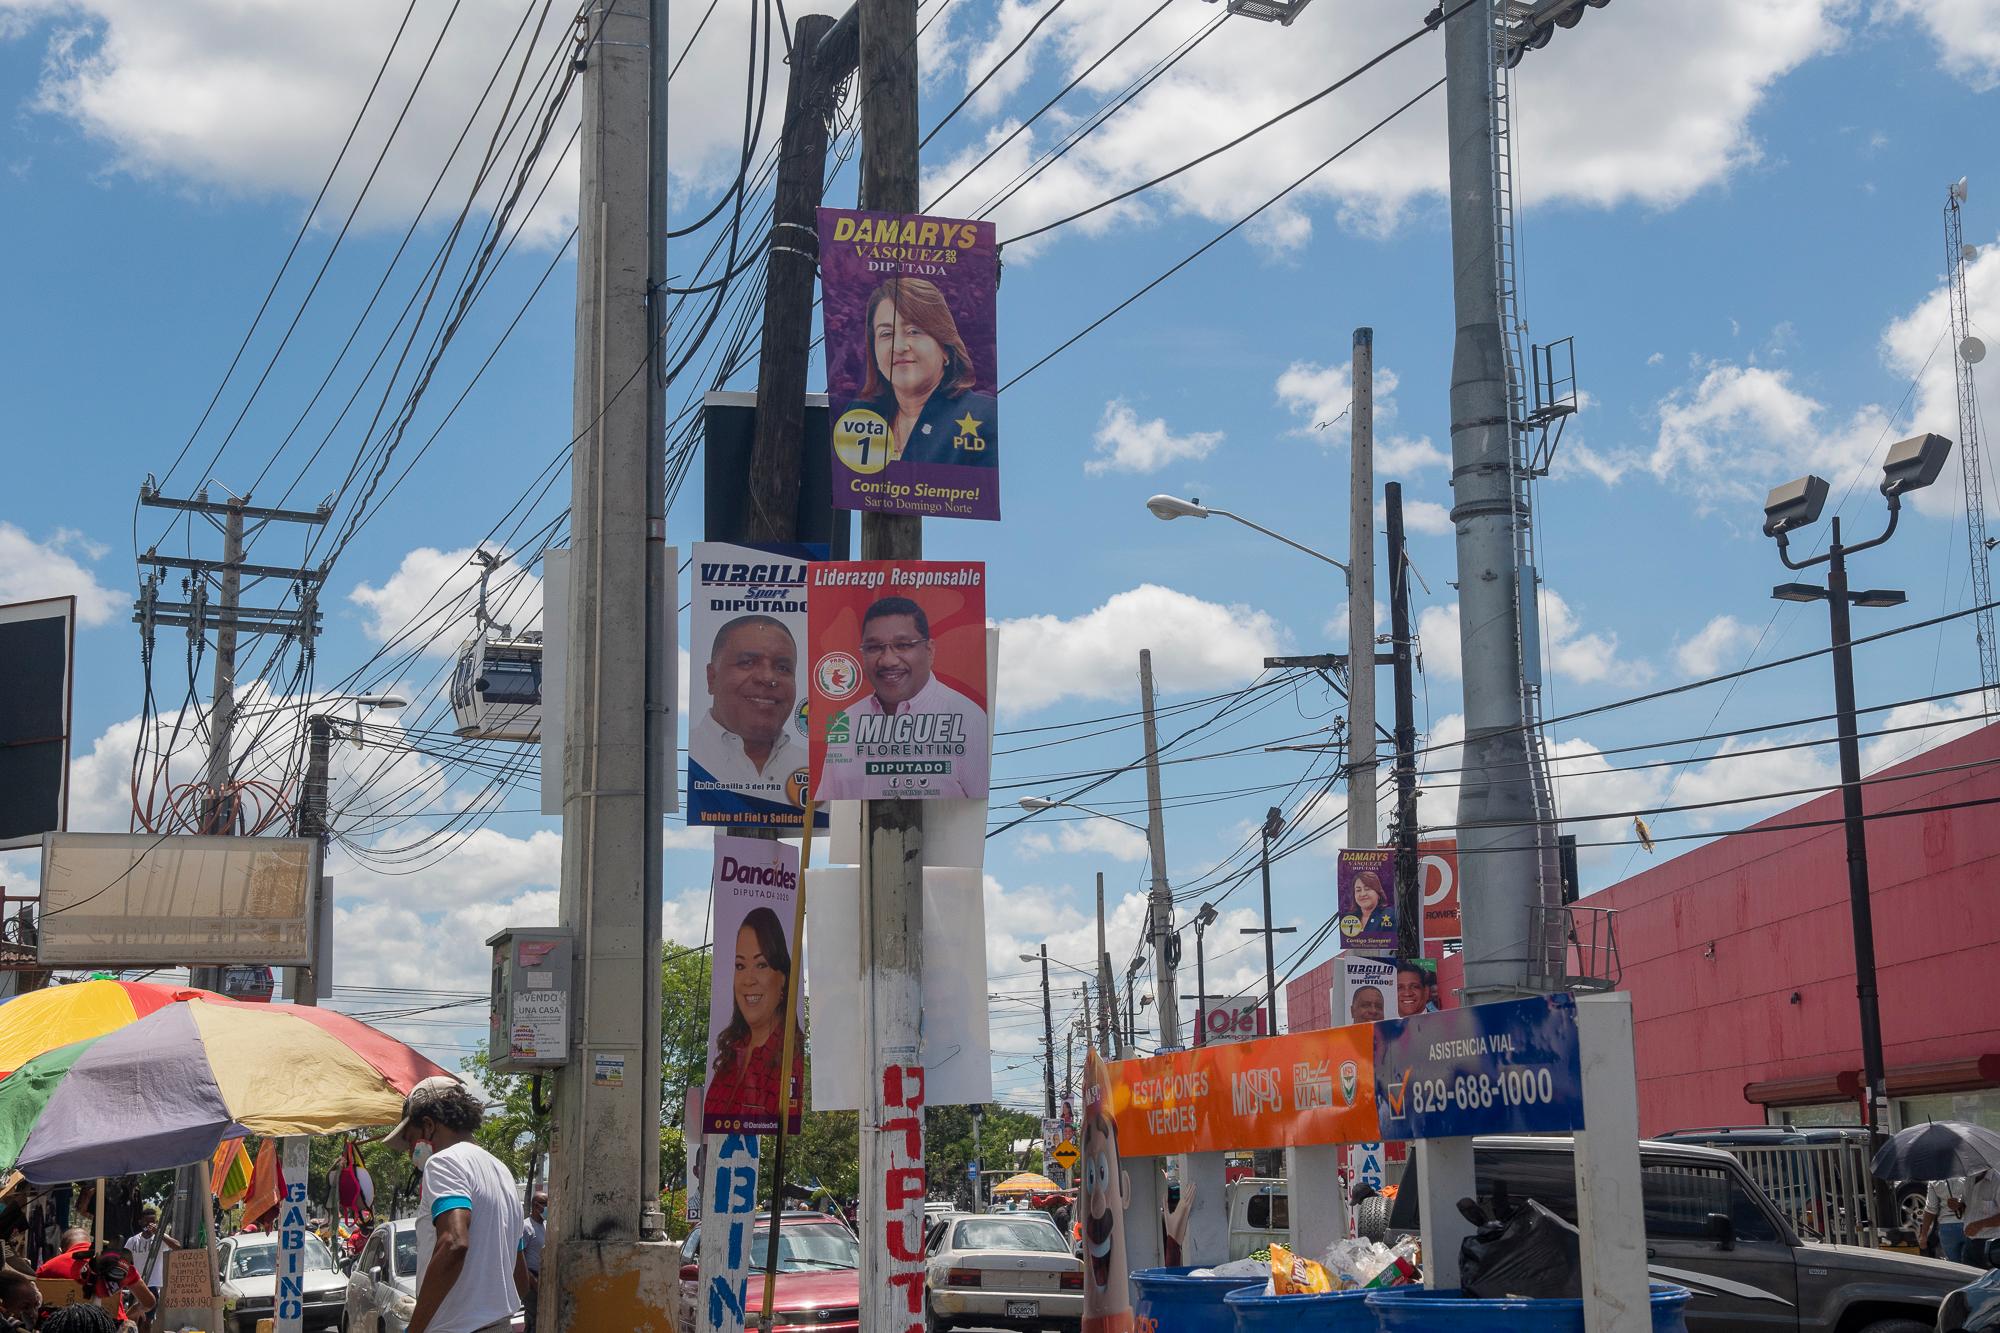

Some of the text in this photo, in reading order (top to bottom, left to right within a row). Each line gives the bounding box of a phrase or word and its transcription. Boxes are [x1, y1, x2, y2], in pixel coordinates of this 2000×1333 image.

[834, 217, 977, 249] DAMARYS
[868, 261, 947, 276] DIPUTADA
[844, 420, 884, 435] vota
[857, 437, 871, 465] 1
[953, 437, 985, 451] PLD
[850, 479, 980, 502] Contigo Siempre!
[896, 498, 942, 513] Domingo
[945, 501, 973, 513] Norte
[814, 567, 981, 589] Liderazgo Responsable
[744, 587, 789, 600] Sport
[855, 714, 966, 744] MIGUEL
[827, 734, 848, 743] FP
[856, 744, 965, 756] FLORENTINO
[871, 763, 943, 773] DIPUTADO
[695, 781, 704, 789] En
[715, 782, 743, 790] Casilla
[766, 783, 781, 791] PRD
[1343, 852, 1389, 862] DAMARYS
[720, 856, 796, 890] Danaides
[1347, 964, 1394, 975] VIRGILIO
[524, 993, 558, 1002] VENDO
[519, 1006, 560, 1014] UNA CASA
[1429, 1033, 1516, 1061] ASISTENCIA VIAL
[1133, 1071, 1209, 1105] ESTACIONES
[1295, 1085, 1327, 1107] VIAL
[1413, 1067, 1553, 1114] 829-688-1000
[1147, 1105, 1197, 1136] VERDES
[880, 1064, 926, 1333] DIPUT
[279, 1182, 306, 1320] GABINO
